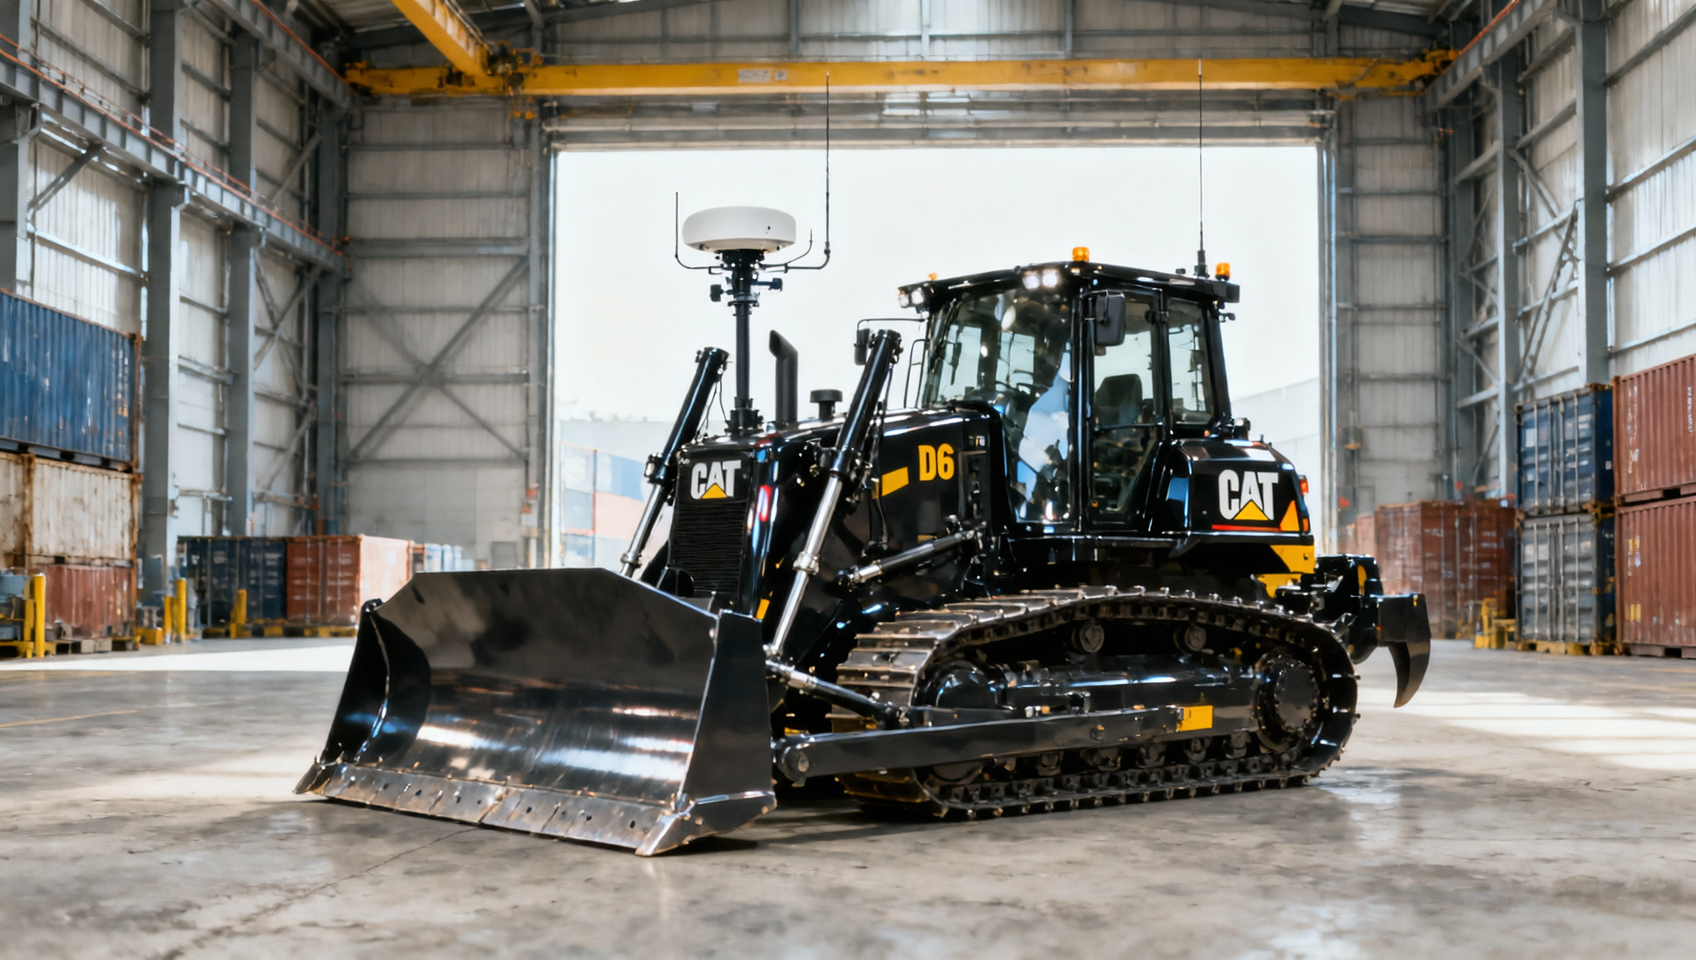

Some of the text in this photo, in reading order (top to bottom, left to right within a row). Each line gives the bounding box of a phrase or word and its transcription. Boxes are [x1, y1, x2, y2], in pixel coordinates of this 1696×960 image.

[690, 460, 742, 500] CAT
[917, 442, 955, 481] D6
[1218, 469, 1279, 520] CAT
